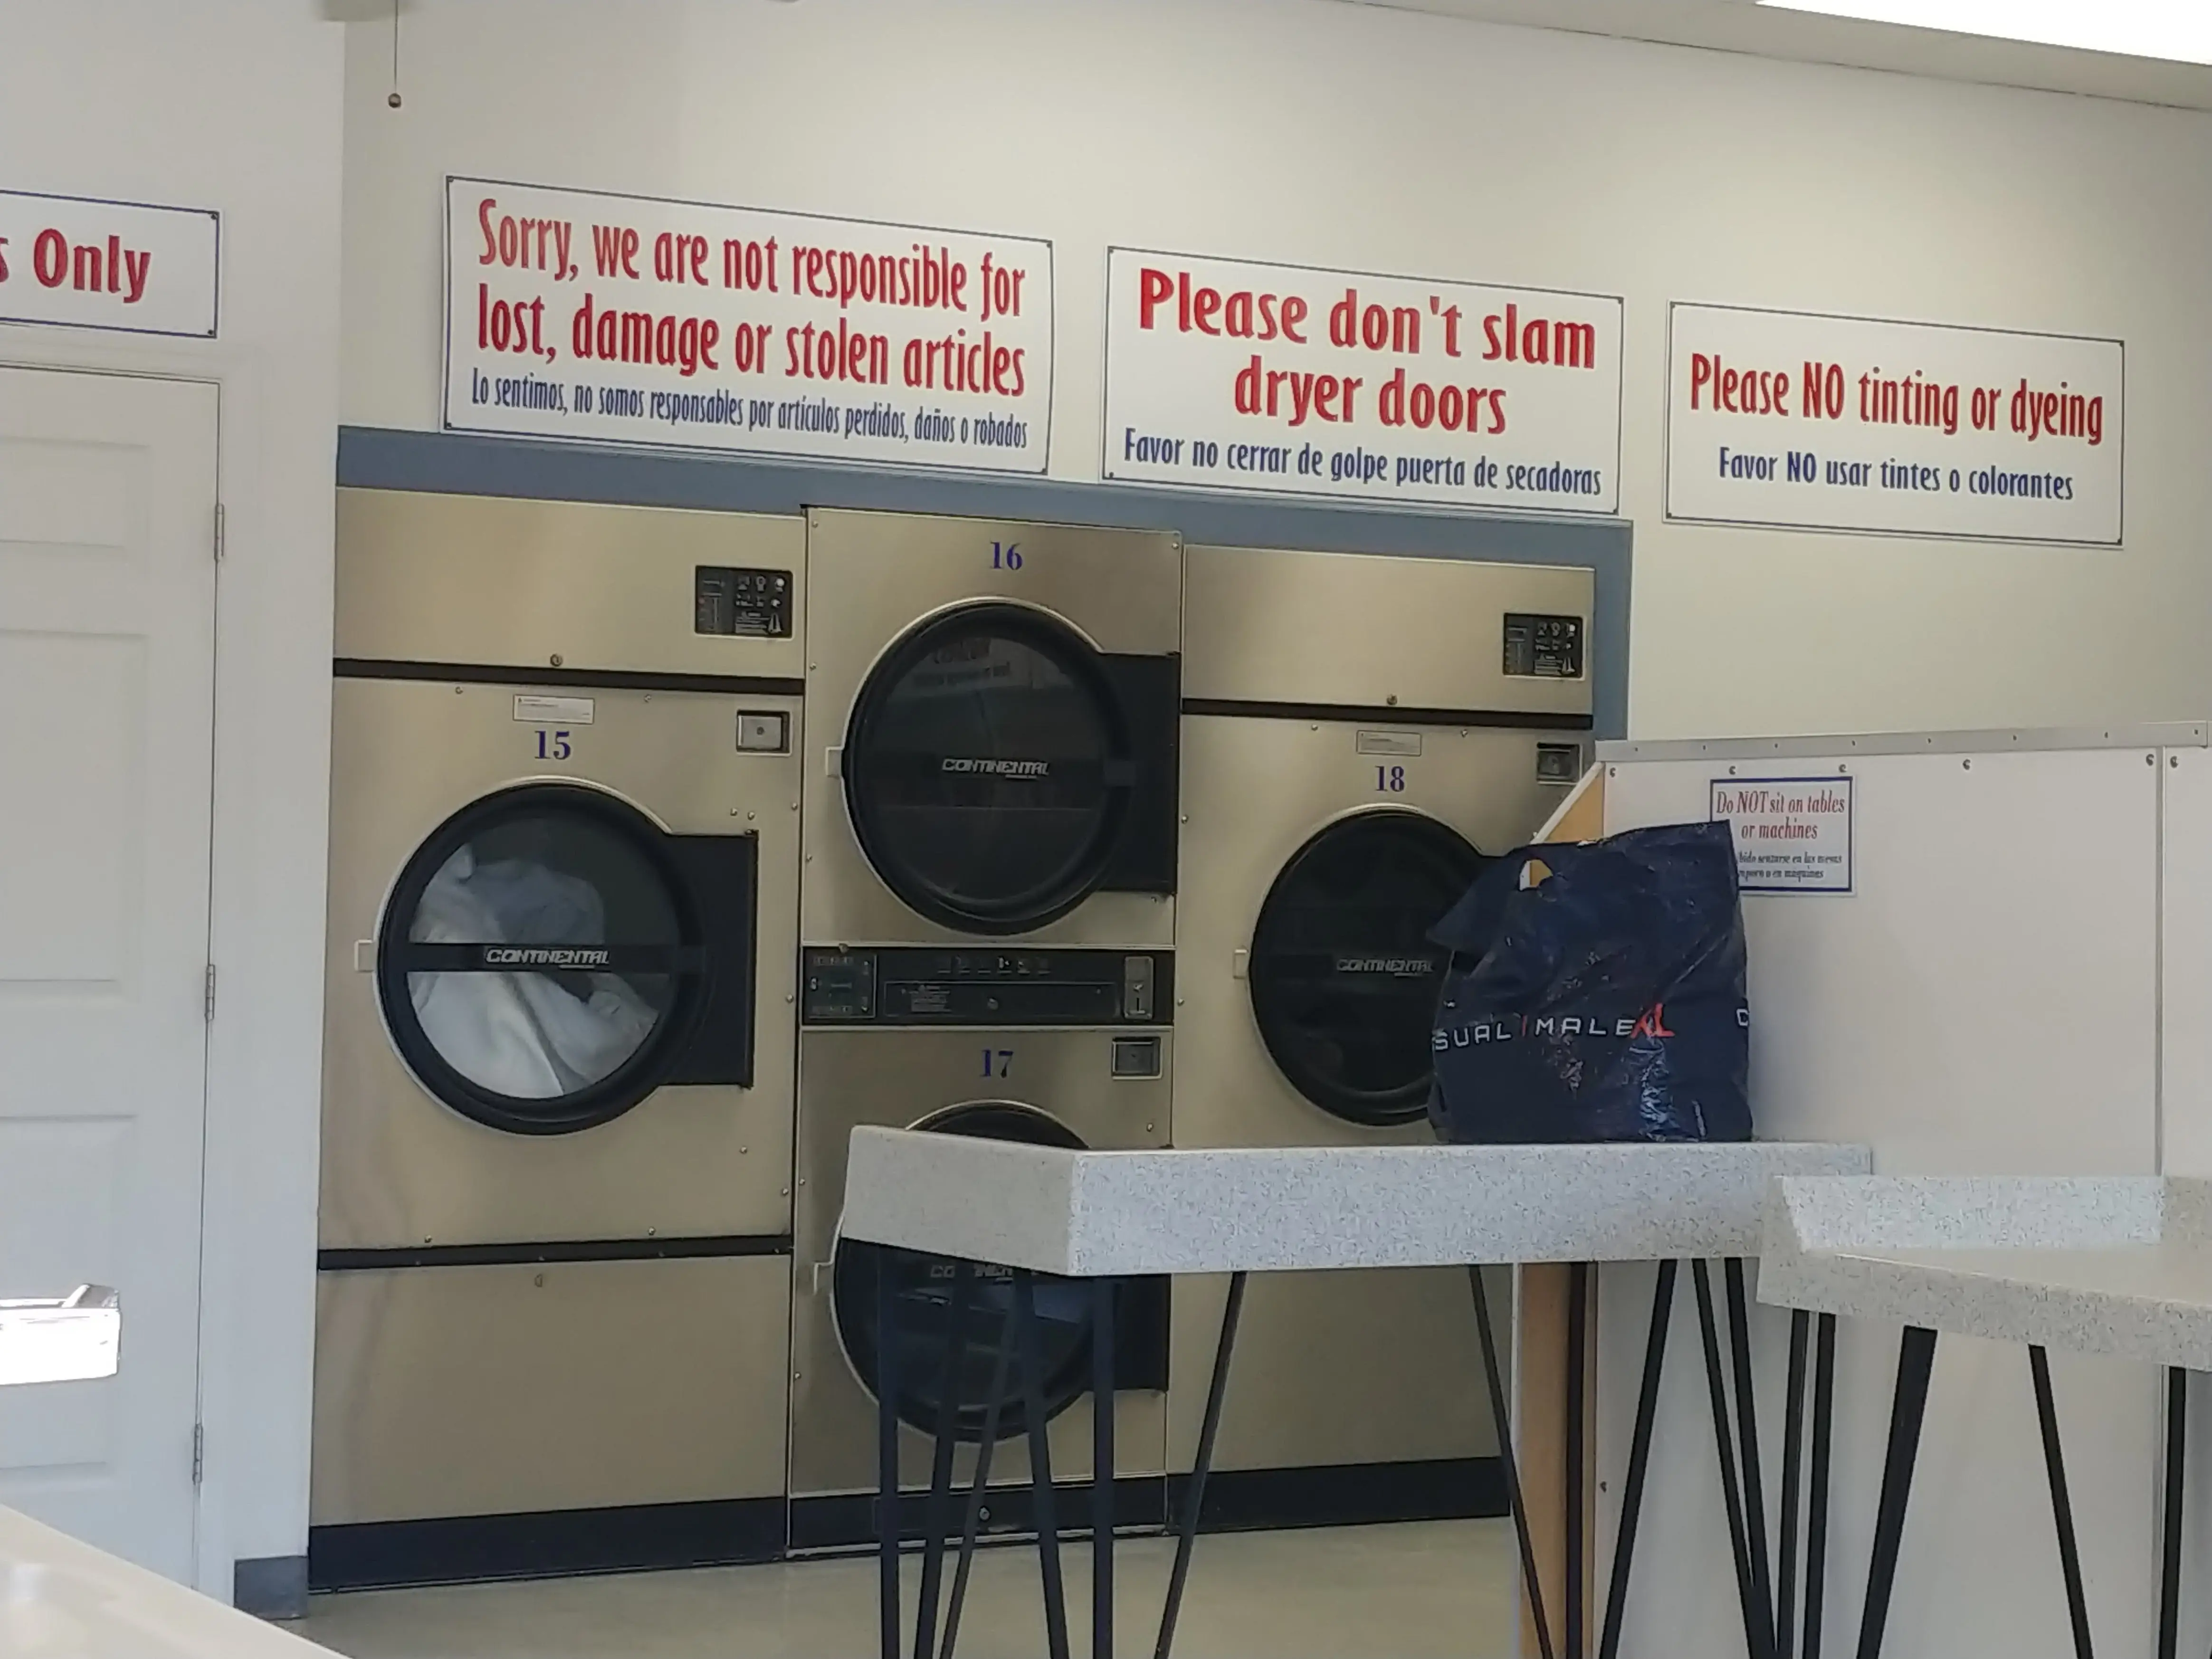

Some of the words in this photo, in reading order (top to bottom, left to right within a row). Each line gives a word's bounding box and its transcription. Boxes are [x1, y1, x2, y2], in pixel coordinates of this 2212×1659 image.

[33, 229, 150, 303] Only
[479, 200, 577, 280] Sorry,
[593, 226, 639, 278] we
[654, 232, 708, 285] are
[723, 239, 778, 293] not
[792, 244, 966, 311] responsible
[981, 253, 1024, 322] for
[479, 283, 556, 362] lost,
[572, 293, 719, 376] damage
[735, 323, 772, 373] or
[785, 317, 888, 384] stolen
[904, 329, 1024, 396] articles
[1140, 268, 1307, 343] Please
[1329, 289, 1459, 357] don't
[1483, 304, 1595, 369] slam
[472, 367, 489, 404] Lo
[494, 372, 568, 416] sentimos,
[574, 385, 592, 413] no
[599, 387, 644, 417] somos
[650, 389, 743, 425] responsables
[749, 400, 774, 431] por
[845, 402, 908, 443] perdidos,
[915, 406, 955, 442] daños
[961, 418, 968, 443] o
[974, 412, 1027, 448] robados
[1235, 355, 1362, 426] dryer
[1379, 368, 1505, 434] doors
[1691, 353, 1788, 415] Please
[1803, 362, 1844, 418] NO
[1860, 372, 1958, 434] tinting
[1971, 388, 2000, 429] or
[2011, 381, 2102, 445] dyeing
[1125, 428, 1184, 465] Favor
[1192, 441, 1218, 468] no
[1228, 444, 1292, 473] cerrar
[1298, 442, 1323, 476] de
[1331, 447, 1387, 484] golpe
[1396, 457, 1465, 486] puerta
[1474, 456, 1497, 488] de
[1506, 461, 1601, 496] secadoras
[1720, 447, 1778, 481] Favor
[1787, 451, 1816, 483] NO
[1826, 461, 1872, 486] usar
[1880, 458, 1940, 491] tintes
[1949, 469, 1960, 492] o
[1969, 465, 2073, 500] colorantes
[990, 542, 1023, 570] 16
[534, 731, 571, 760] 15
[942, 759, 1049, 775] CONTINENTAL
[1375, 766, 1405, 792] 18
[1716, 791, 1734, 813] Do
[1736, 790, 1769, 813] NOT
[1770, 792, 1784, 813] sit
[1788, 798, 1803, 813] on
[1807, 789, 1845, 813] tables
[1741, 824, 1755, 839] or
[1759, 816, 1818, 839] machines
[486, 949, 609, 964] CONTINENTAL
[980, 1049, 1014, 1078] 17
